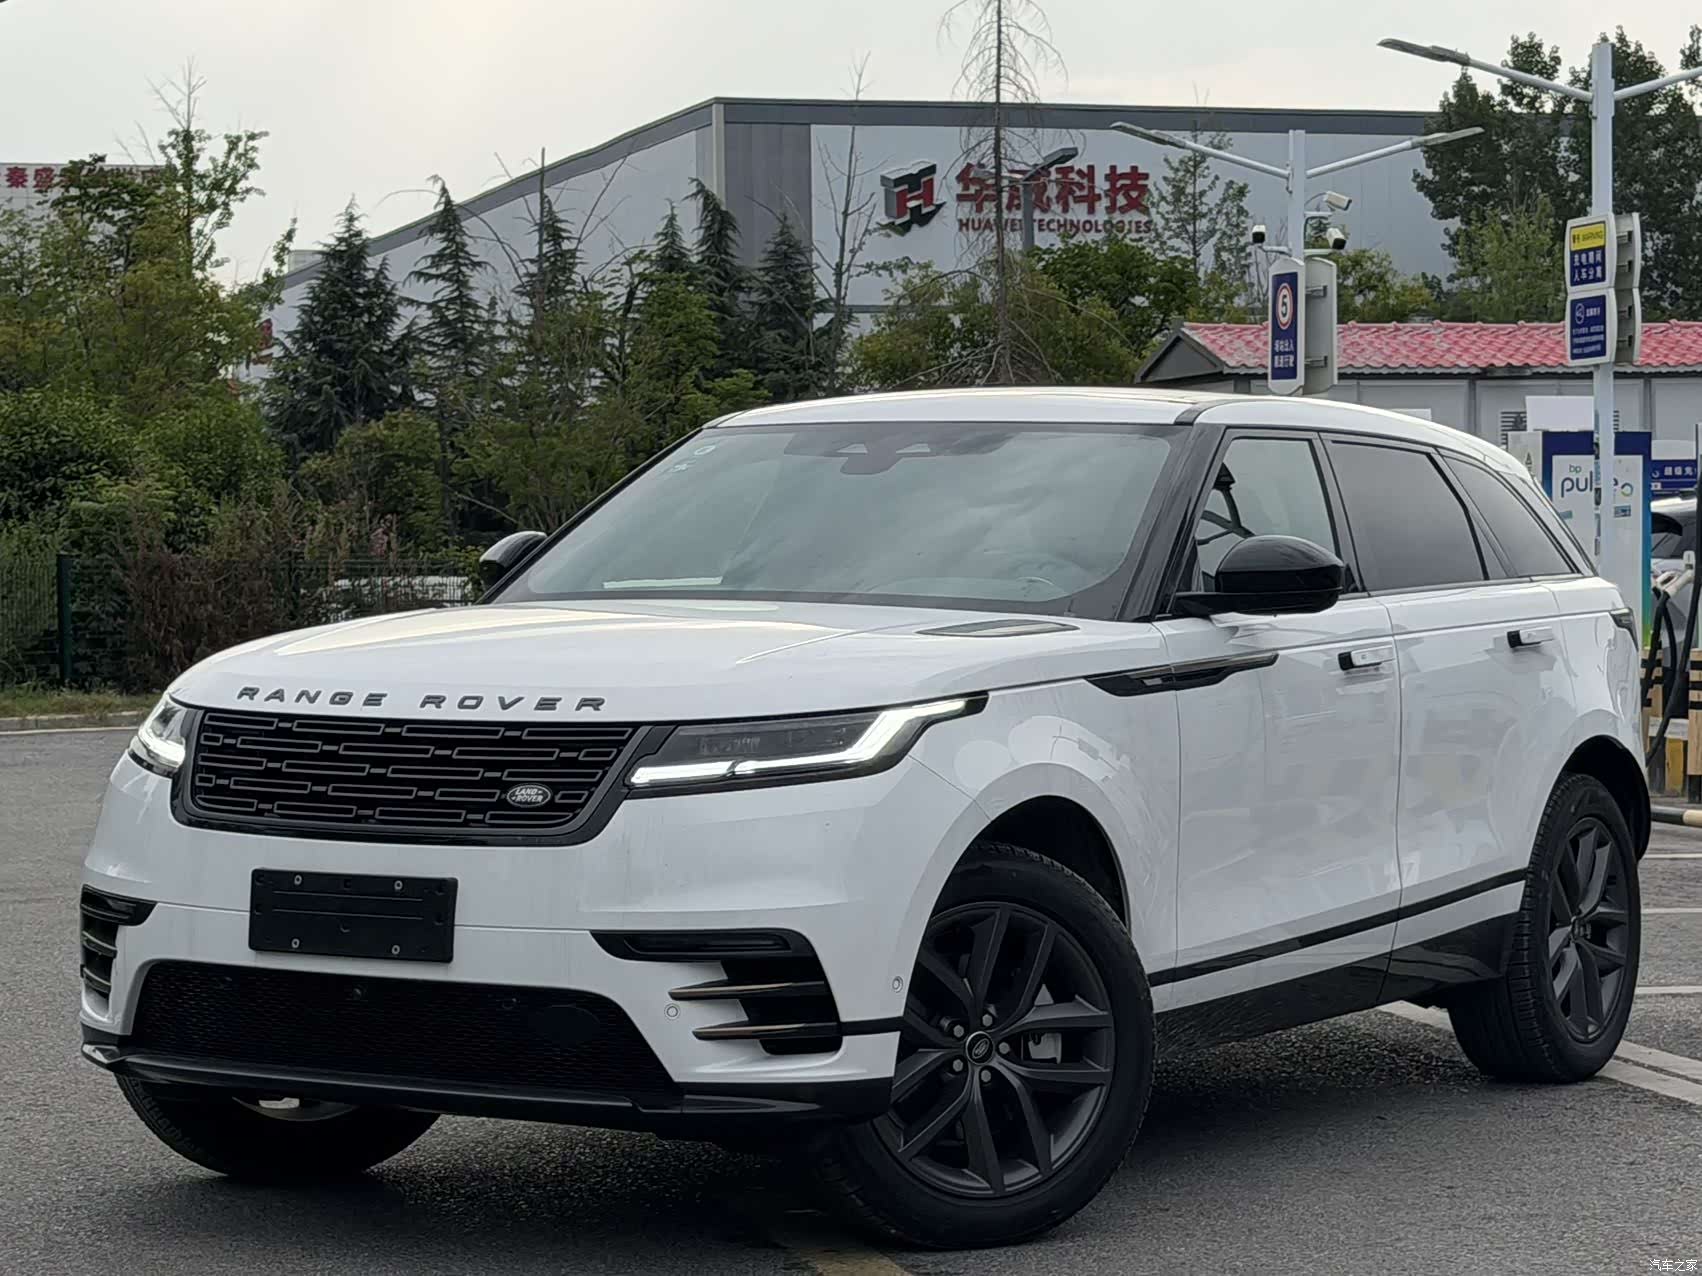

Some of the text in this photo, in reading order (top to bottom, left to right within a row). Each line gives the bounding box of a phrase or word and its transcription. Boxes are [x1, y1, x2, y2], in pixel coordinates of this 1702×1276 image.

[1031, 217, 1152, 234] ECHNOLOGIES
[1281, 293, 1288, 318] 5
[1569, 464, 1582, 475] bp
[1561, 470, 1619, 498] pul
[237, 686, 606, 712] RANGE ROVER
